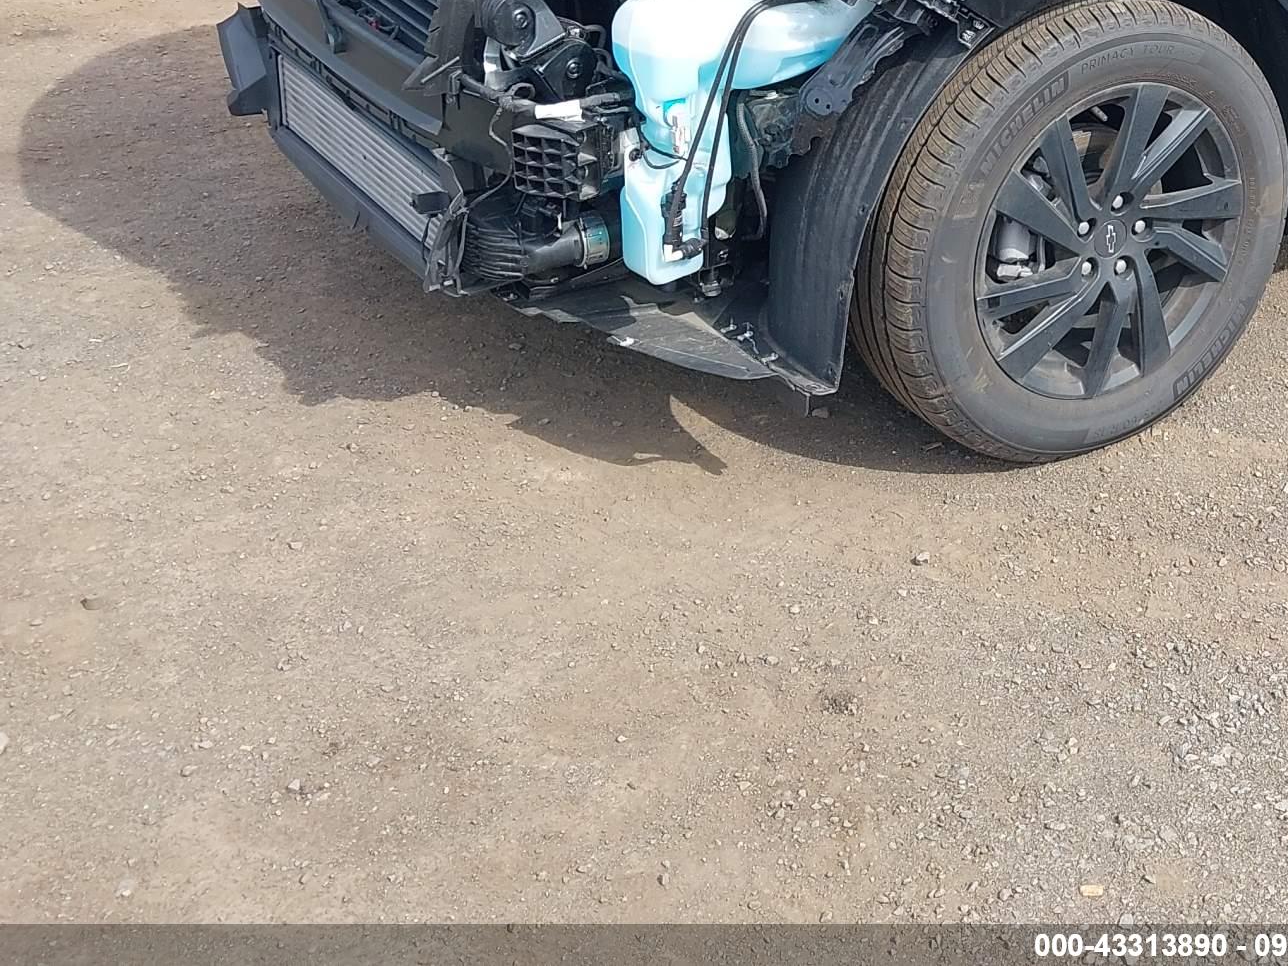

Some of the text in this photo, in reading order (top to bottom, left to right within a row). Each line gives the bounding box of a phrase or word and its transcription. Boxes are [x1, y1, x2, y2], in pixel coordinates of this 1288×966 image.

[1081, 44, 1175, 74] PRIMACY TOUR
[979, 77, 1066, 176] MICHELIN
[1175, 300, 1250, 397] MICHELIN
